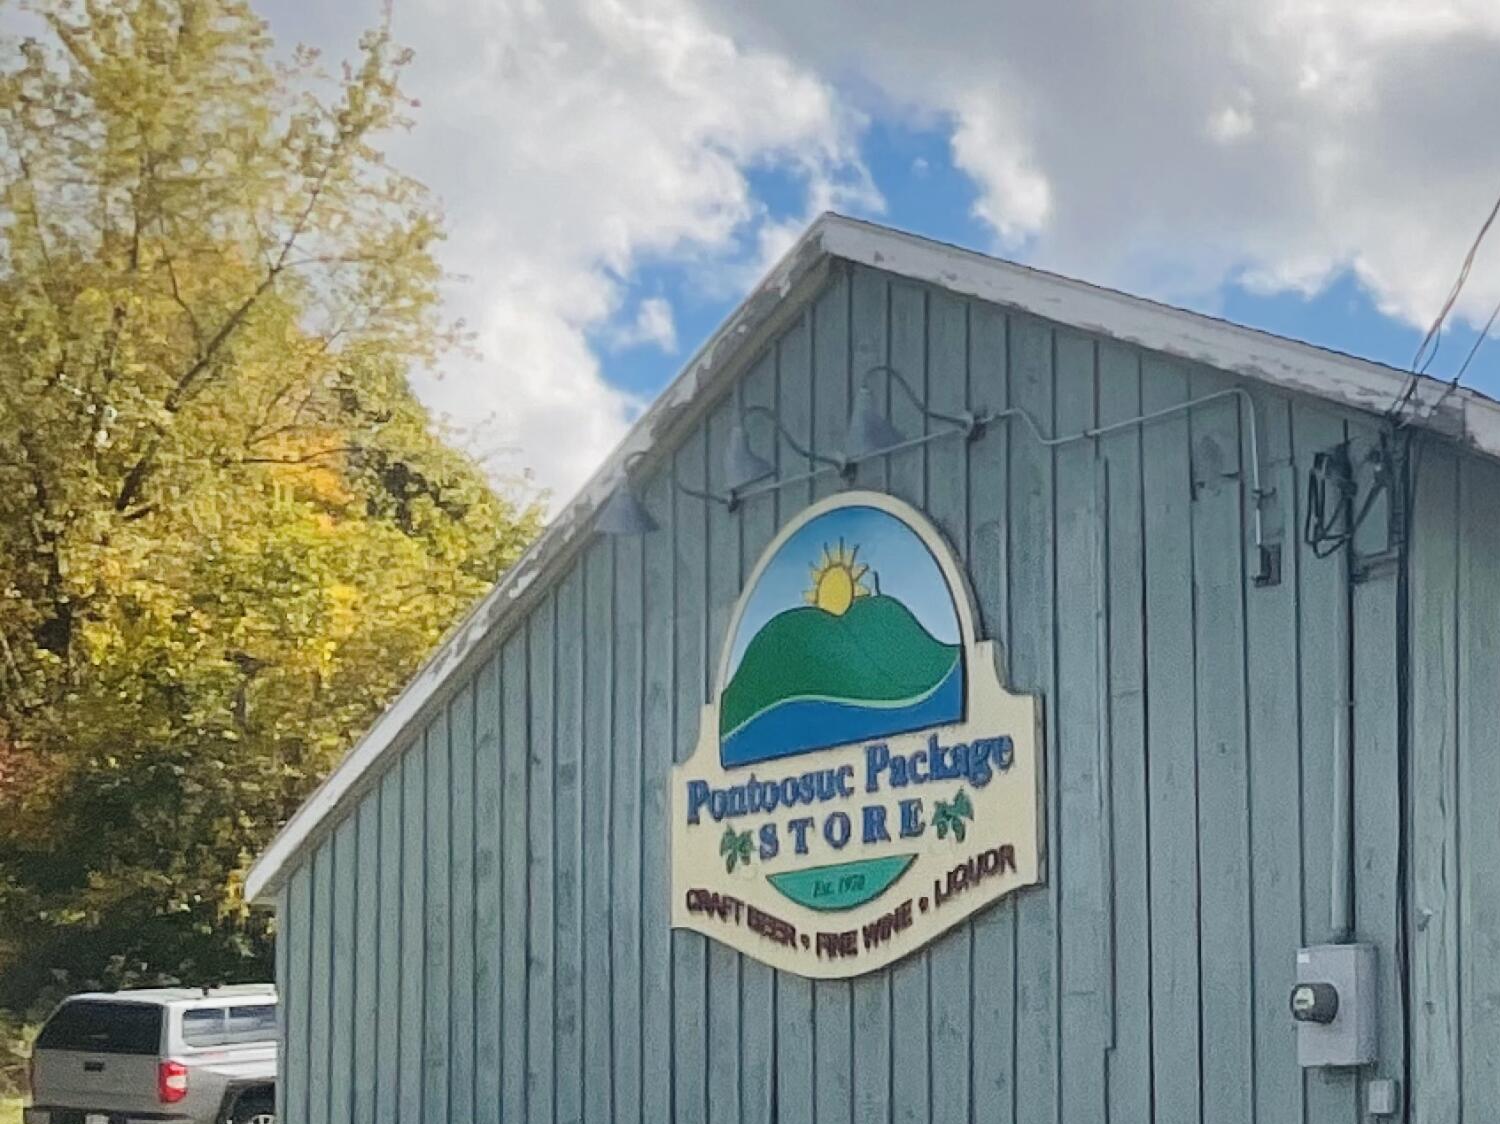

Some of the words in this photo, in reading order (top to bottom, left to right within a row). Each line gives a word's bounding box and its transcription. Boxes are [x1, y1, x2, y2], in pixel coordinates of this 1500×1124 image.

[686, 764, 854, 825] Pontoosuc
[864, 734, 1014, 788] Package
[759, 798, 925, 861] STORE
[687, 888, 745, 926] CRAFT
[747, 904, 797, 949] BEER
[862, 898, 913, 952] WINE
[934, 844, 1017, 907] LIQUOR
